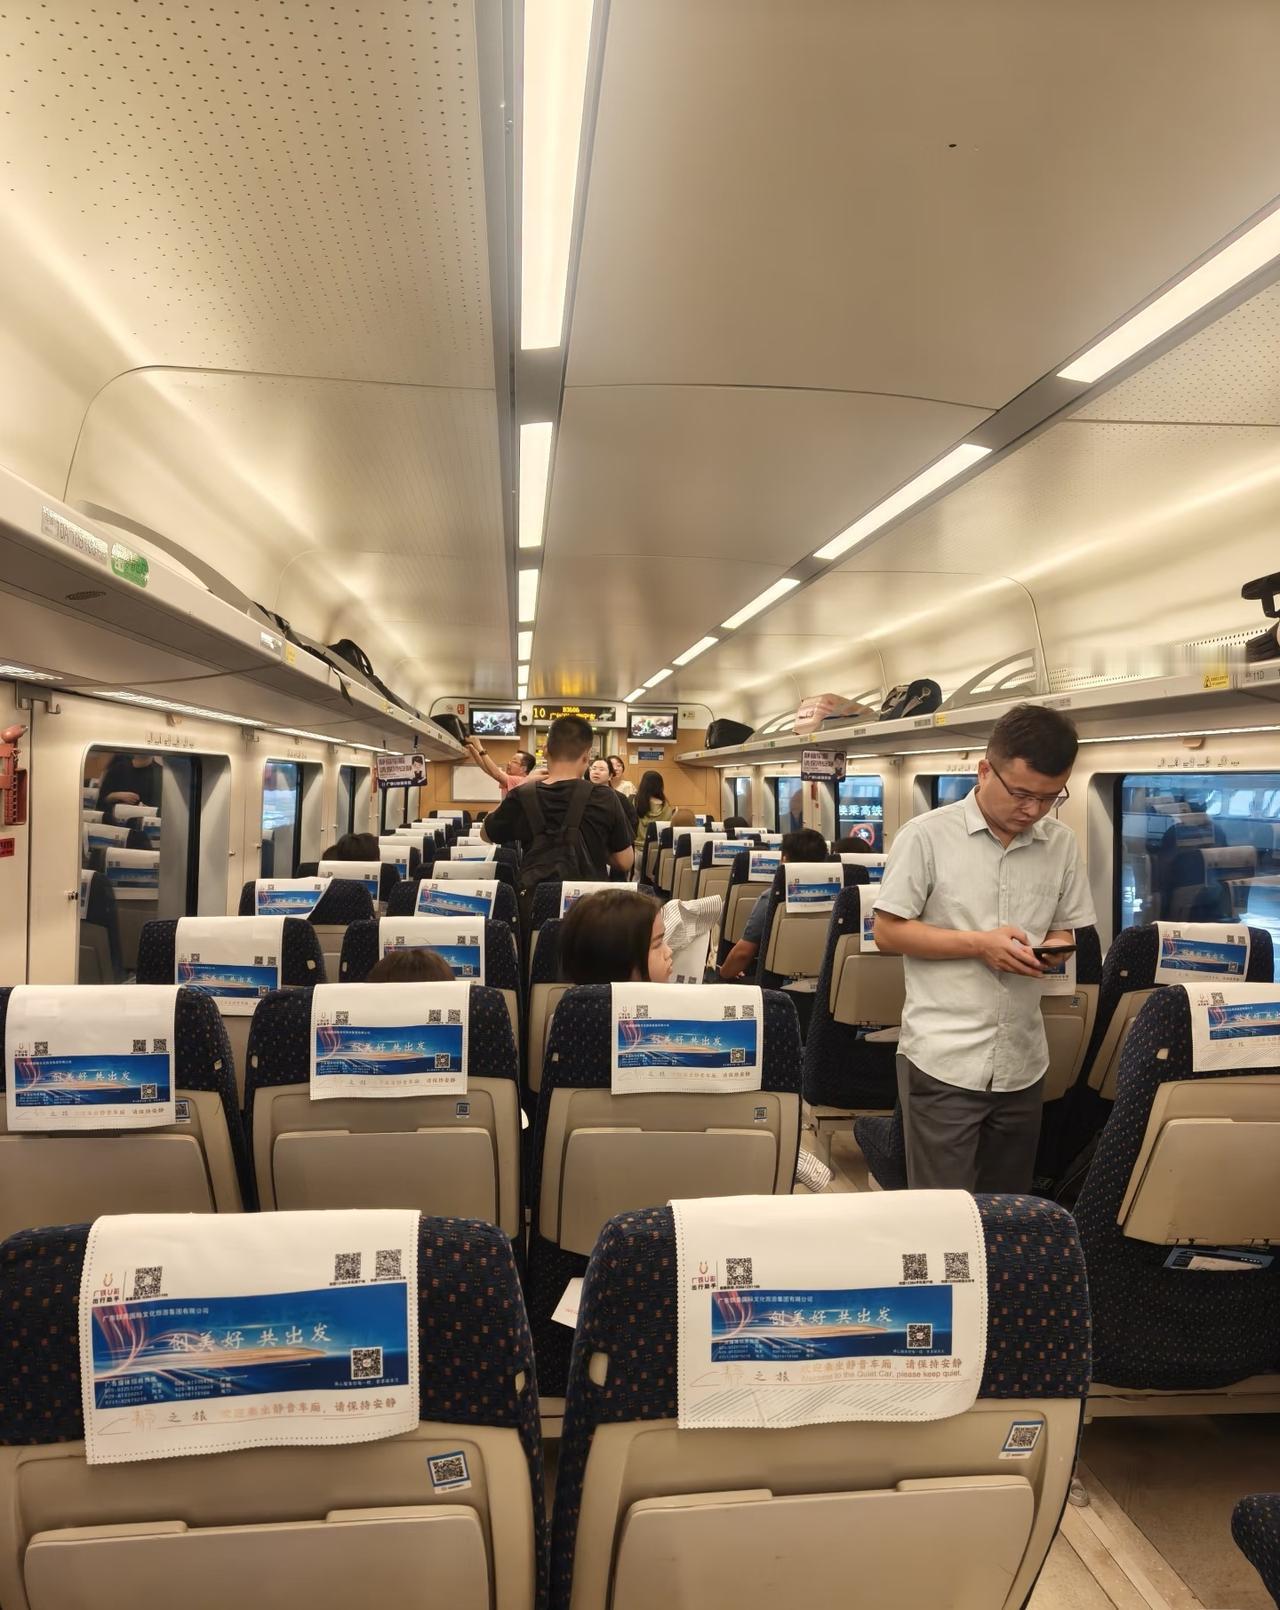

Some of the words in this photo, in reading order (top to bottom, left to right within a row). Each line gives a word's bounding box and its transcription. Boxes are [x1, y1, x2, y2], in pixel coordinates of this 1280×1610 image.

[533, 707, 546, 719] 10
[835, 1307, 893, 1326] 共出发
[256, 1322, 333, 1347] 共出发
[857, 1369, 878, 1379] Quiet
[896, 1369, 922, 1380] please
[922, 1369, 941, 1380] keep
[942, 1368, 962, 1379] quiet.
